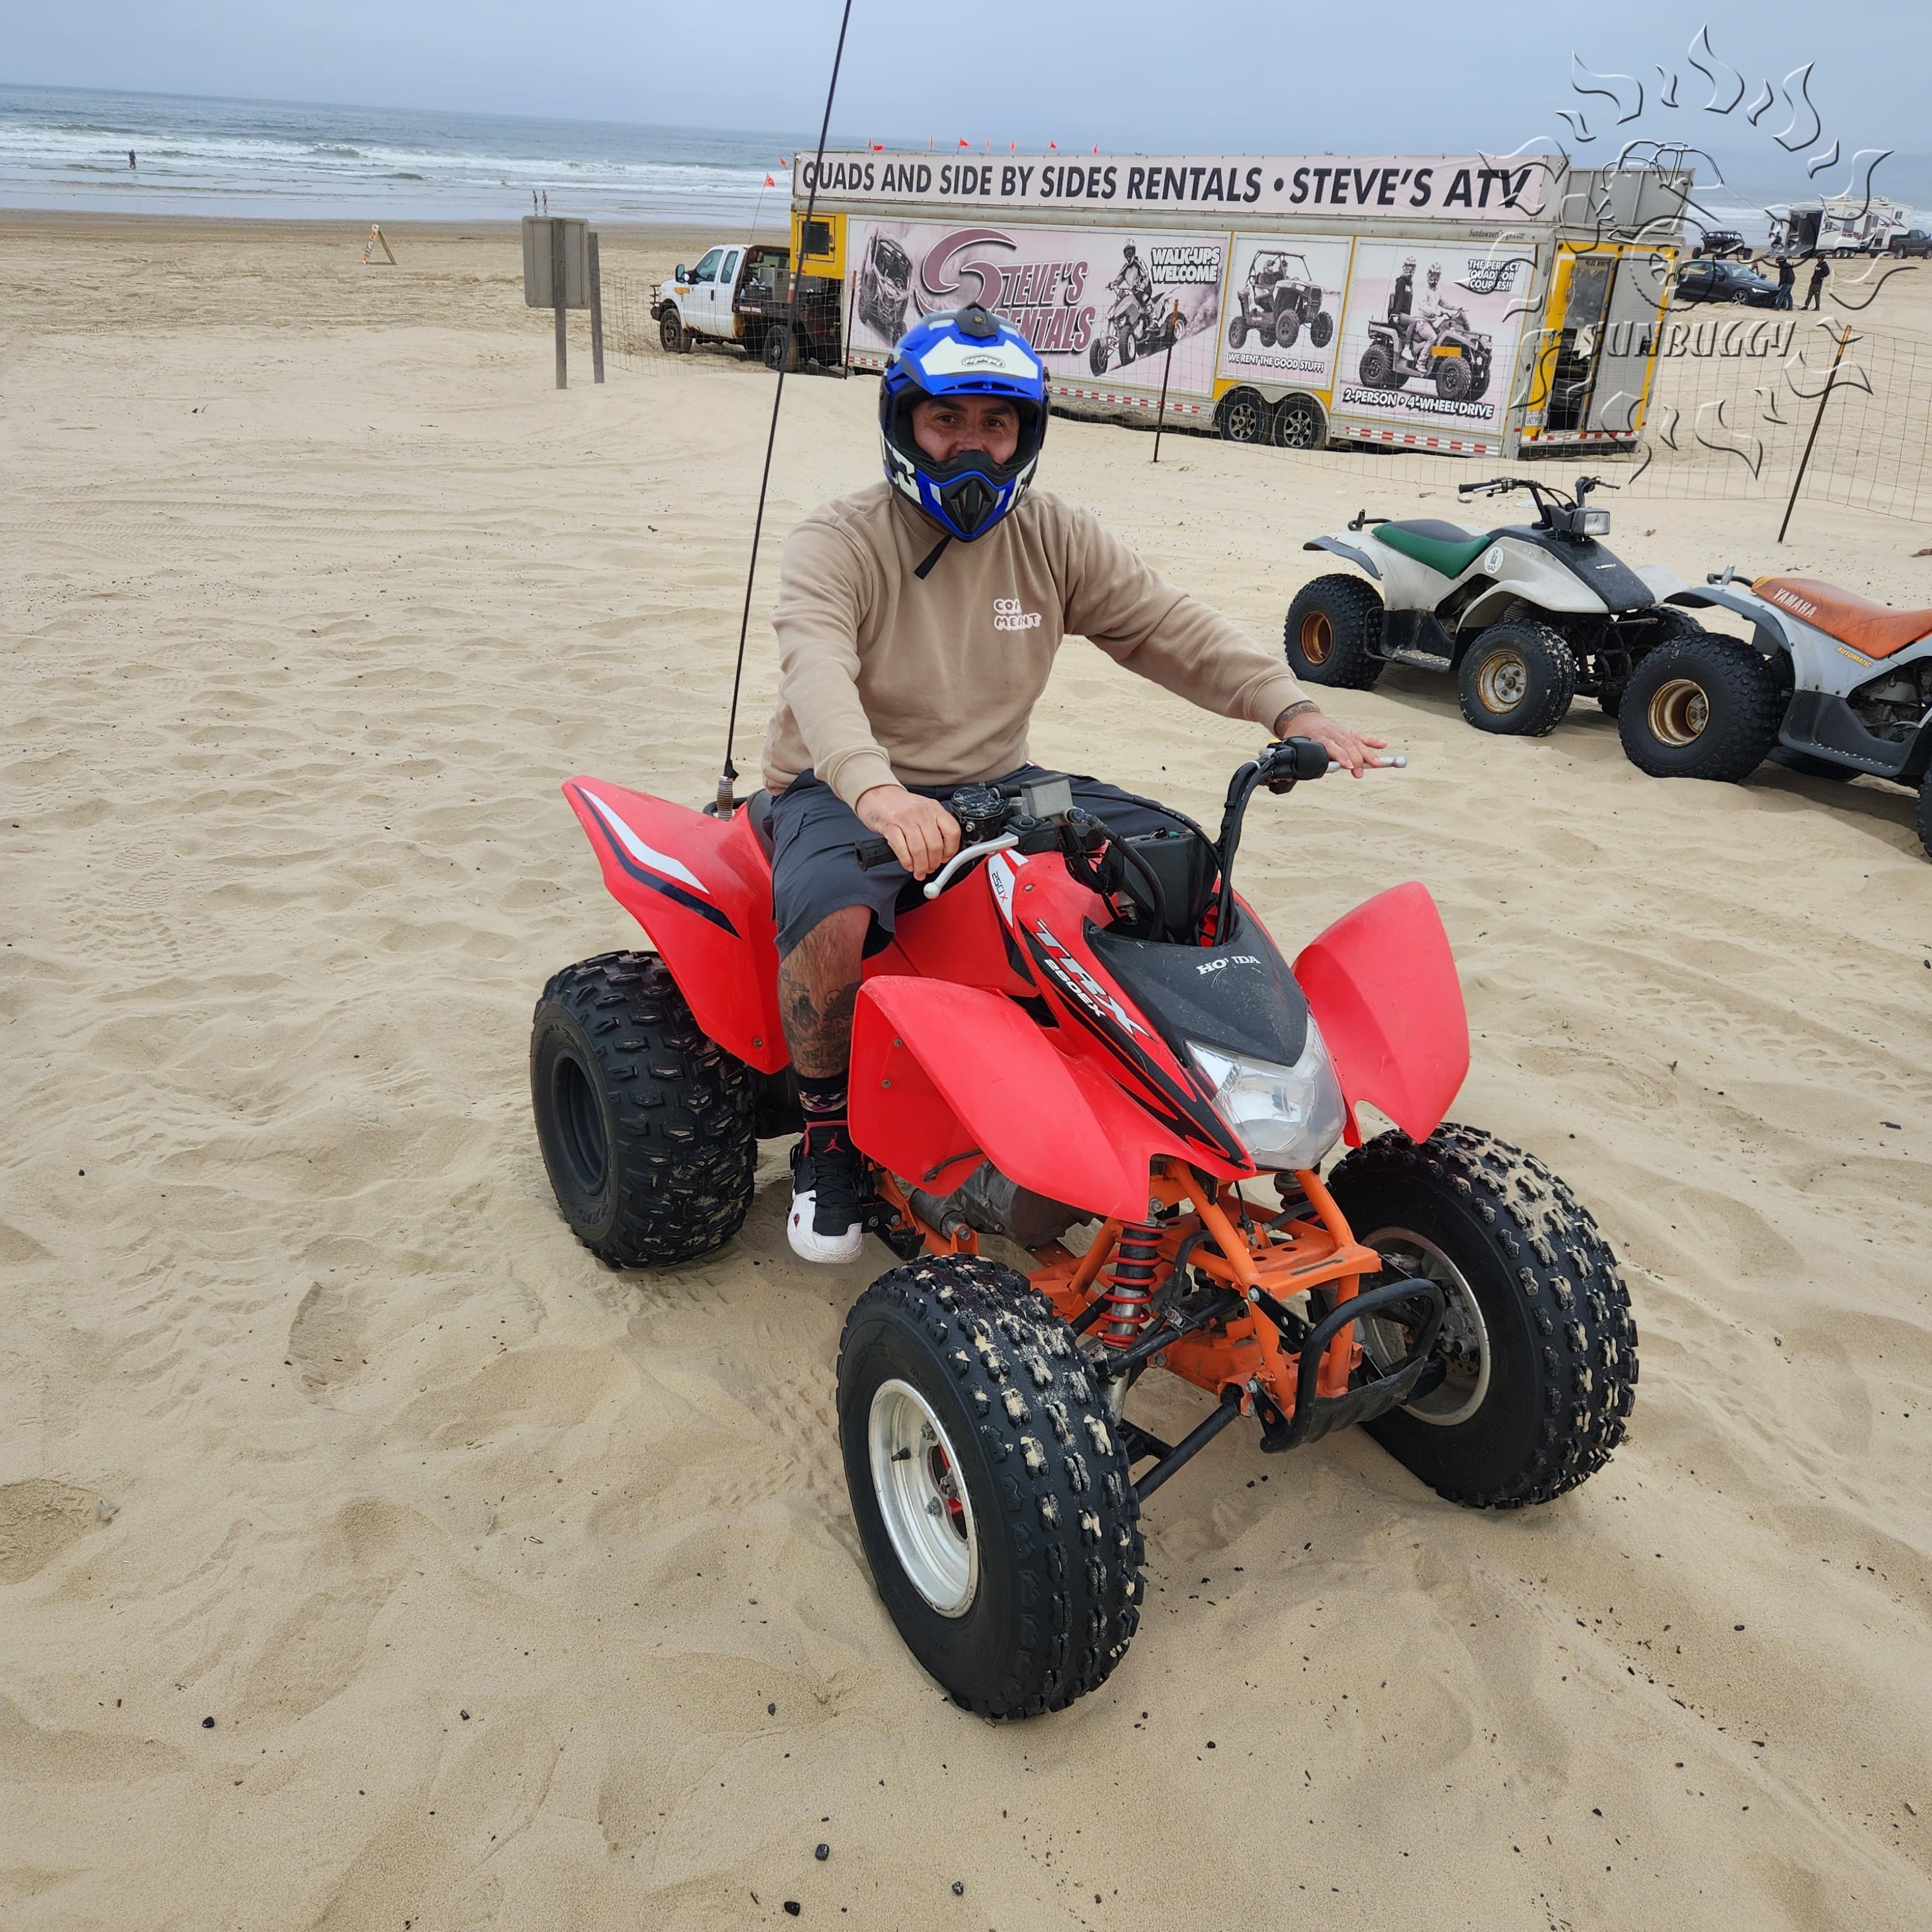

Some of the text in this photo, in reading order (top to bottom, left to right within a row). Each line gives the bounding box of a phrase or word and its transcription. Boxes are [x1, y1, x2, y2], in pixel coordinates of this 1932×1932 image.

[803, 161, 1532, 209] QUADS AND SIDE BY SIDES RENTALS STEVE'S ATV
[1151, 247, 1220, 265] WALK-UPS
[1468, 260, 1486, 269] THE
[914, 227, 1089, 315] STEVE'S
[1151, 265, 1218, 283] WELCOME
[1470, 269, 1516, 281] QUAD OR
[1228, 353, 1324, 373] WE RENT THE GOOD STUFF!
[1343, 388, 1495, 419] 2-PERSON 4-WHEEL DRIVE
[1773, 588, 1818, 618] YAMAHA
[994, 613, 1042, 631] MENT
[1836, 646, 1873, 668] AUTOMATIC
[991, 870, 1008, 903] 250X
[1034, 918, 1159, 1044] TRX
[1043, 958, 1107, 1017] 250EX
